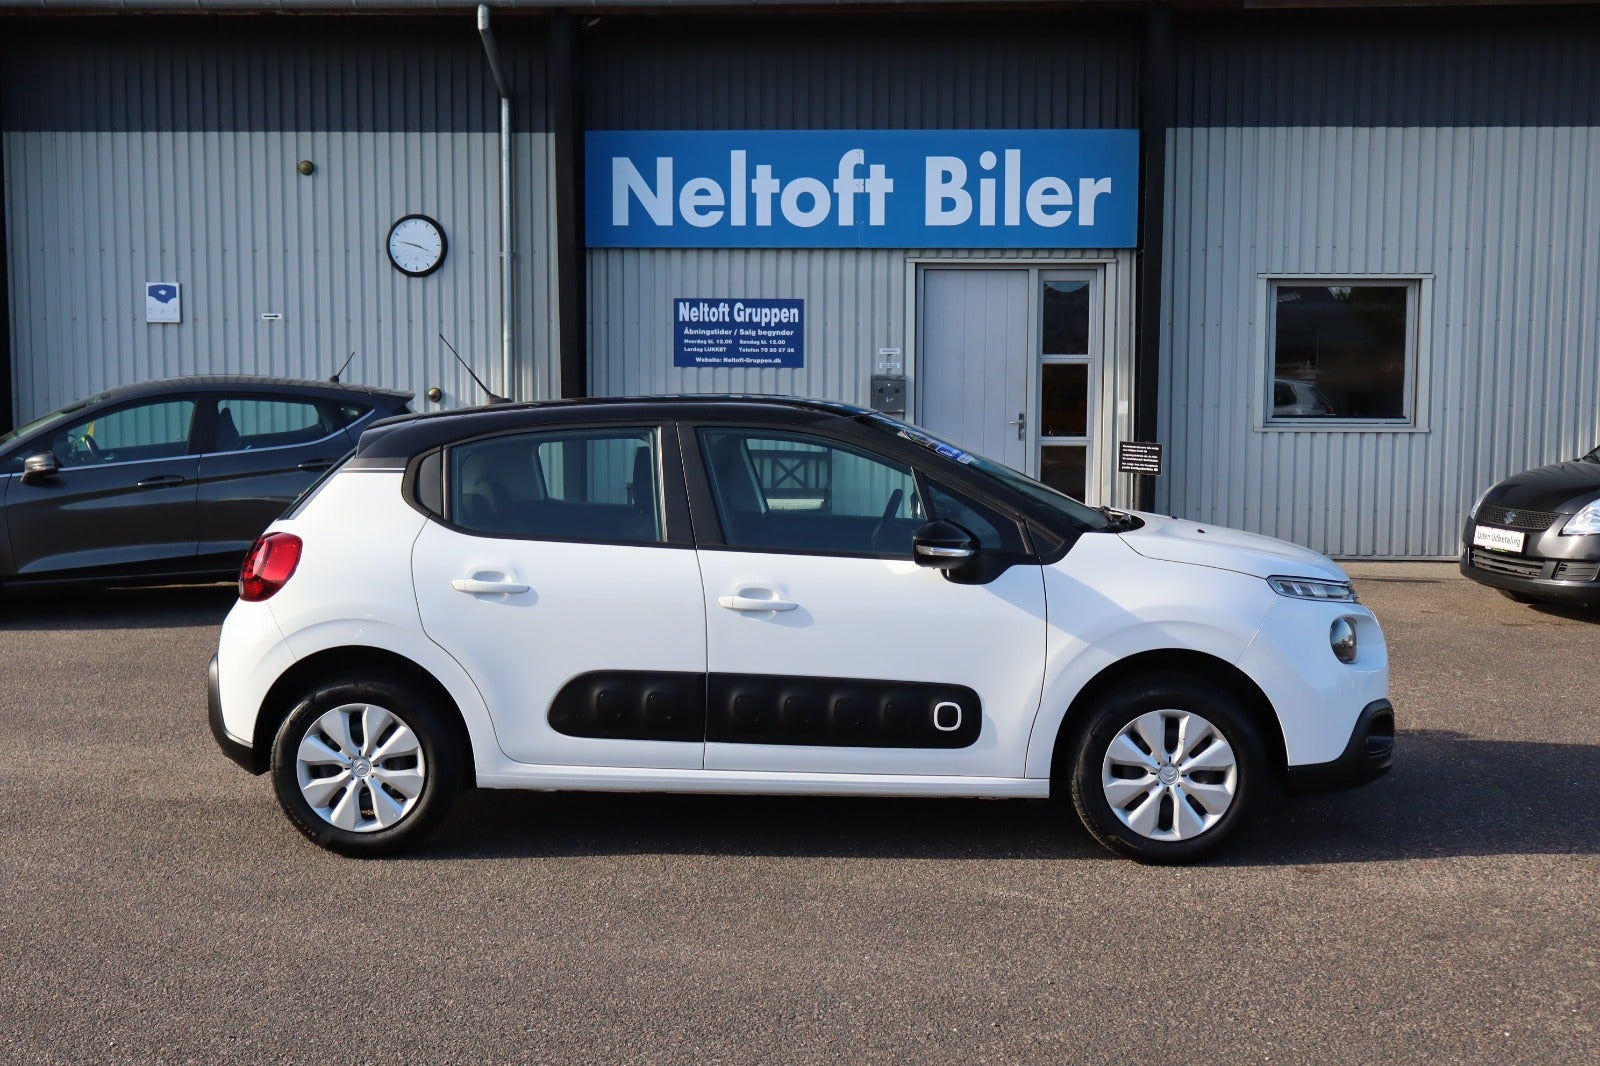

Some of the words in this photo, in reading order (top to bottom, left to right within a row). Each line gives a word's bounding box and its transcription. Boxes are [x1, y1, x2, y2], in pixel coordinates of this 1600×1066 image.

[612, 149, 893, 228] Neltoft
[926, 149, 1112, 228] Biler
[679, 302, 730, 322] Neltoft
[734, 302, 799, 327] Gruppen
[684, 327, 732, 336] Åbningstider
[739, 329, 756, 337] Salg
[758, 329, 794, 337] begynder
